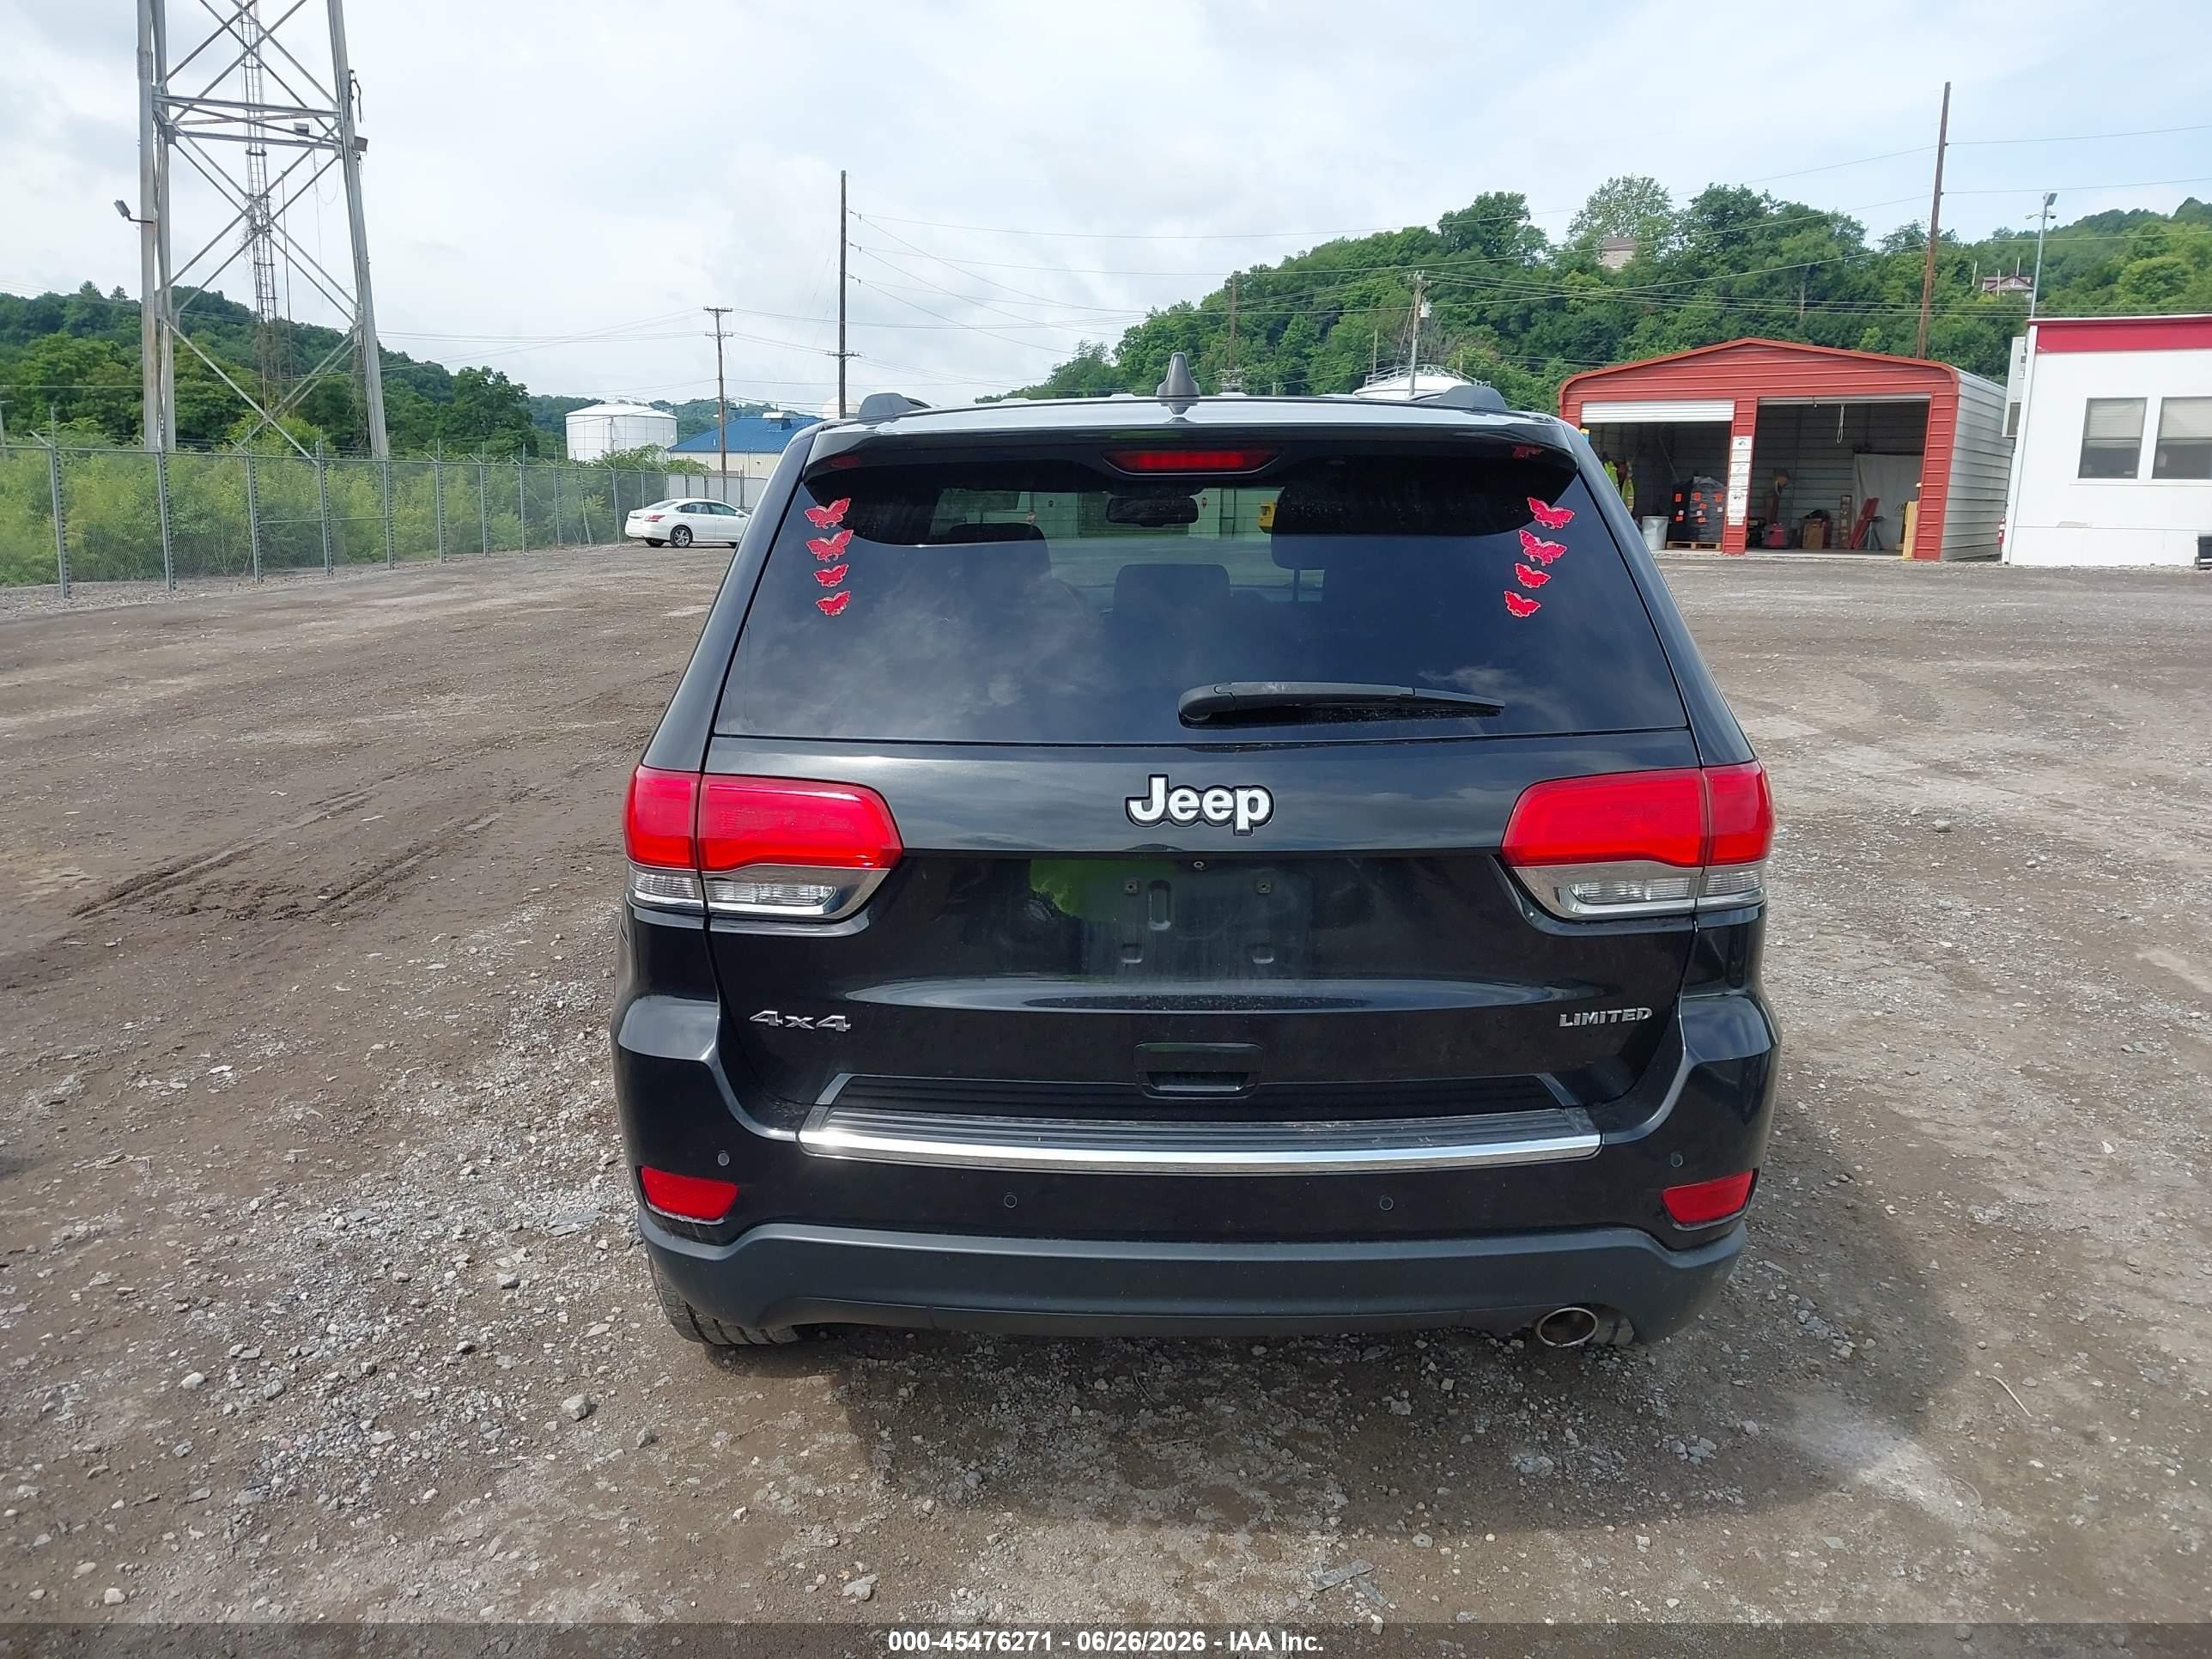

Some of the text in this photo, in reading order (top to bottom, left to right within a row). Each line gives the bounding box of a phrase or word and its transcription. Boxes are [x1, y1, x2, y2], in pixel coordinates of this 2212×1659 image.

[1127, 775, 1272, 831] Jeep
[749, 1010, 852, 1032] 4x4
[1559, 1007, 1653, 1027] LIMITED
